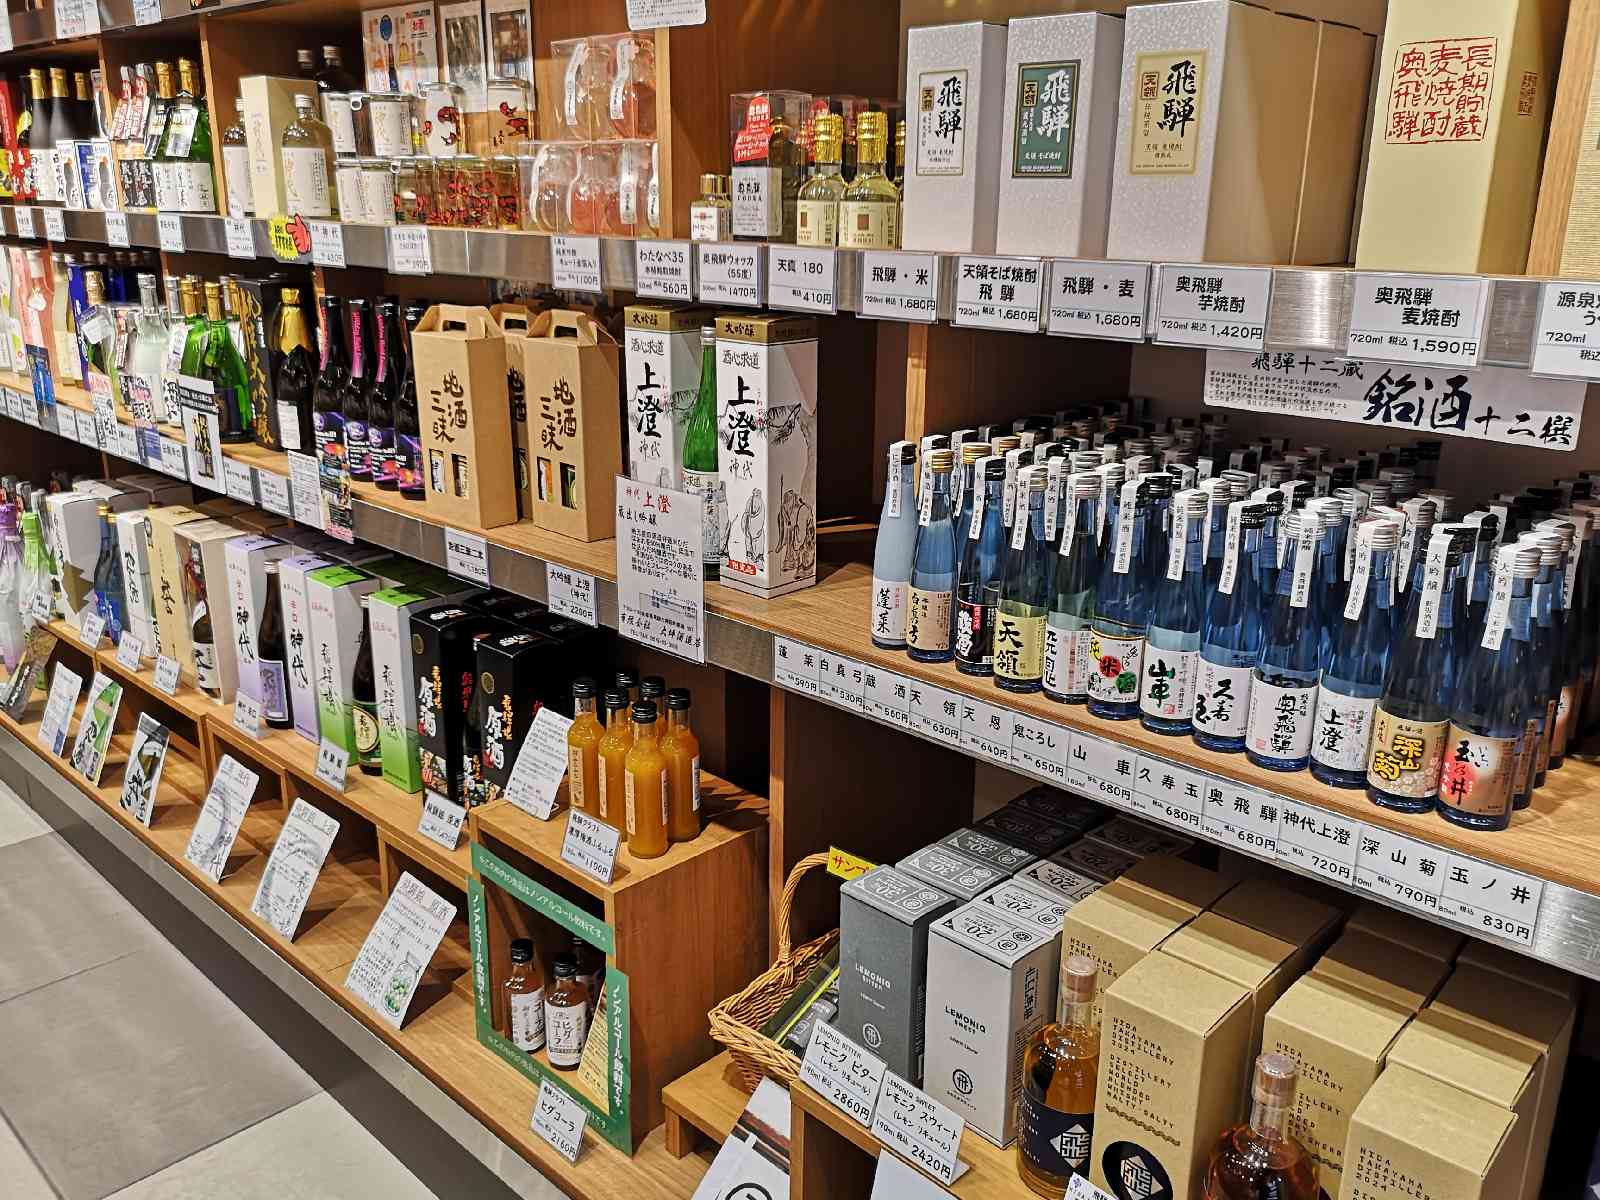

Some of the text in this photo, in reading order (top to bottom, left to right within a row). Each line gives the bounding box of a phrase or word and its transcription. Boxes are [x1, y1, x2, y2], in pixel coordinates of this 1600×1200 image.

[1157, 59, 1197, 138] 飛騨
[1388, 48, 1428, 141] 奥飛騨
[1421, 44, 1463, 137] 麦焼酎
[1451, 44, 1493, 137] 長期貯蔵
[936, 76, 962, 144] 飛騨
[1036, 69, 1071, 143] 飛騨
[640, 250, 684, 263] わたなべ35
[703, 253, 754, 266] 奥飛騨ウォッカ
[803, 262, 824, 274] 180
[872, 266, 929, 285] 飛騨・米
[963, 264, 1037, 283] 天領そば焼酎
[1175, 275, 1223, 294] 奥飛騨
[662, 282, 688, 295] 560円
[729, 286, 756, 298] 1470円
[803, 292, 832, 304] 410円
[1062, 277, 1135, 298] 飛騨・麦
[1375, 287, 1433, 307] 奥飛騨
[899, 298, 936, 311] 1,680円
[958, 308, 980, 316] 720ml
[998, 309, 1038, 321] 1,680円
[1197, 295, 1245, 313] 芋焼酎
[1052, 309, 1141, 327] 720ml 税込 1,680円
[1402, 307, 1461, 328] 麦焼酎
[1161, 320, 1263, 340] 720ml 税込 1,420円
[1546, 332, 1586, 344] 720ml
[1350, 333, 1477, 356] 720ml 税込 1,590円
[636, 362, 664, 438] 上澄
[727, 376, 756, 458] 上澄
[1425, 552, 1442, 591] 大吟醸
[570, 605, 593, 620] 2200円
[778, 644, 814, 668] 蓬莱
[996, 620, 1023, 675] 天領
[820, 658, 862, 683] 白真弓
[795, 677, 817, 692] 590円
[865, 674, 906, 700] 蔵酒
[839, 690, 863, 705] 530円
[911, 690, 956, 718] 天領
[884, 708, 909, 724] 560円
[963, 706, 1001, 731] 天恩
[1271, 693, 1298, 754] 奥飛騨
[932, 724, 959, 739] 630円
[1013, 723, 1056, 749] 鬼ころし
[1320, 708, 1345, 753] 上澄
[981, 742, 1008, 760] 640円
[1073, 745, 1131, 776] 山車
[1035, 759, 1064, 777] 650円
[1099, 781, 1131, 801] 680円
[1138, 767, 1199, 798] 久寿玉
[1166, 806, 1200, 826] 680円
[1208, 788, 1278, 822] 奥飛騨
[1282, 809, 1351, 846] 神代上澄
[1237, 830, 1276, 851] 680円
[1311, 856, 1350, 879] 720円
[1362, 836, 1437, 877] 深山菊
[1394, 883, 1437, 908] 790円
[1449, 866, 1531, 904] 玉ノ井
[1483, 915, 1530, 940] 830円
[855, 963, 891, 989] LEMONIQ
[945, 1006, 986, 1033] LEMONIQ
[815, 1035, 878, 1082] レモニク ビター
[834, 1089, 870, 1120] 2860円
[886, 1088, 916, 1112] レモニク
[920, 1112, 957, 1140] スウィート
[550, 1132, 576, 1158] 2160円
[1360, 1147, 1390, 1166] HIDA
[912, 1145, 951, 1179] 2420円
[1360, 1156, 1422, 1190] TAKAYAMA
[1356, 1172, 1387, 1192] 2024
